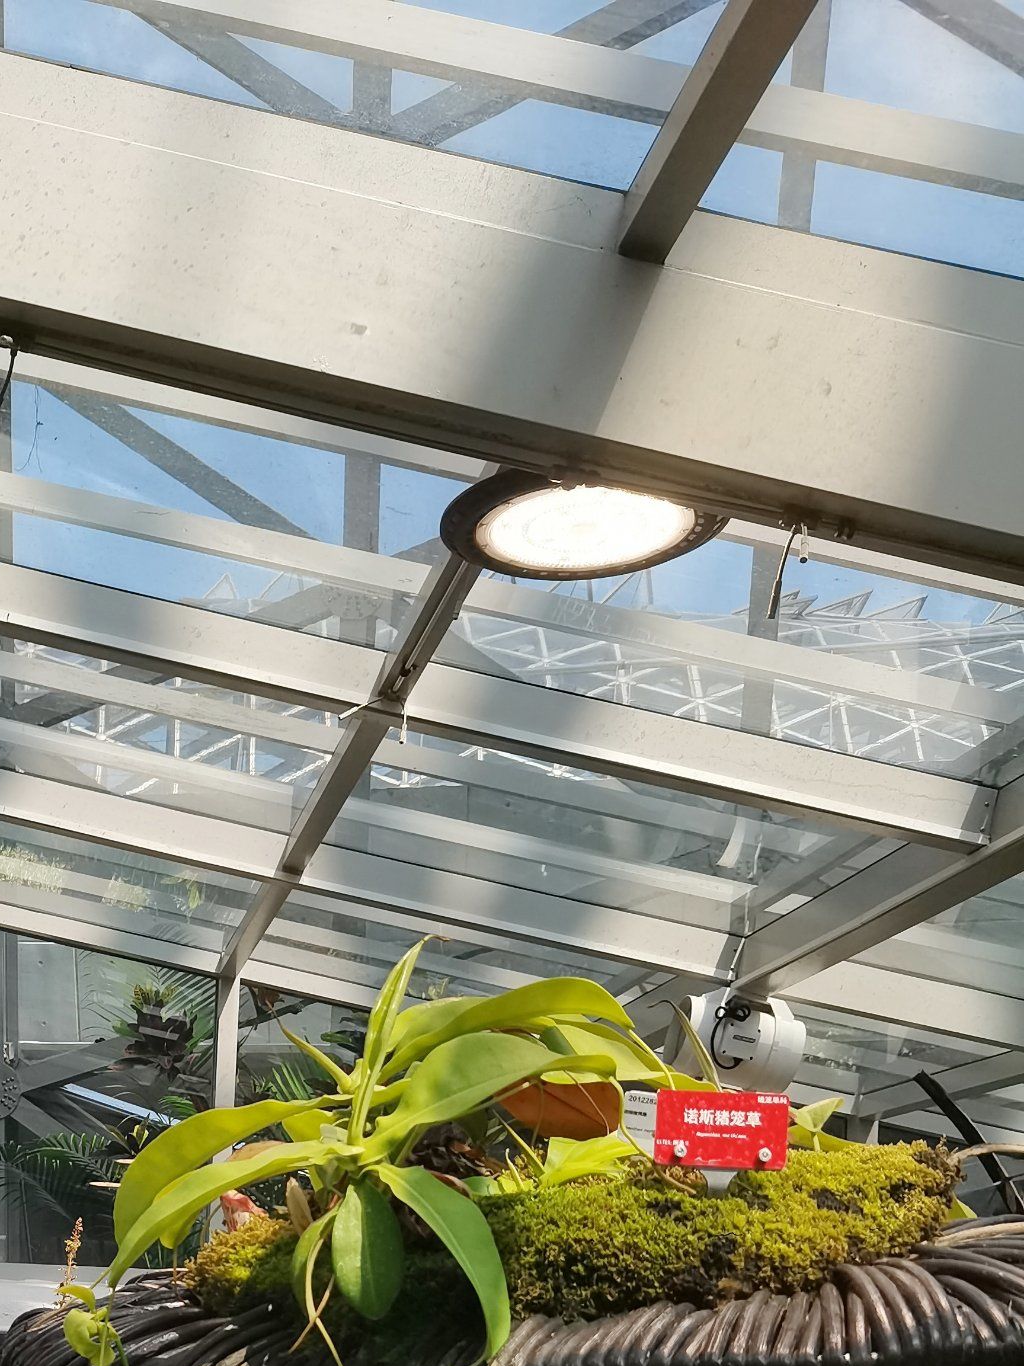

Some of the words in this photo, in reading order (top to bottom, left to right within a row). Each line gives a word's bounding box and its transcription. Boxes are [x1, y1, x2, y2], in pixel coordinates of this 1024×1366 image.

[683, 1108, 762, 1128] 诺斯猪笼草
